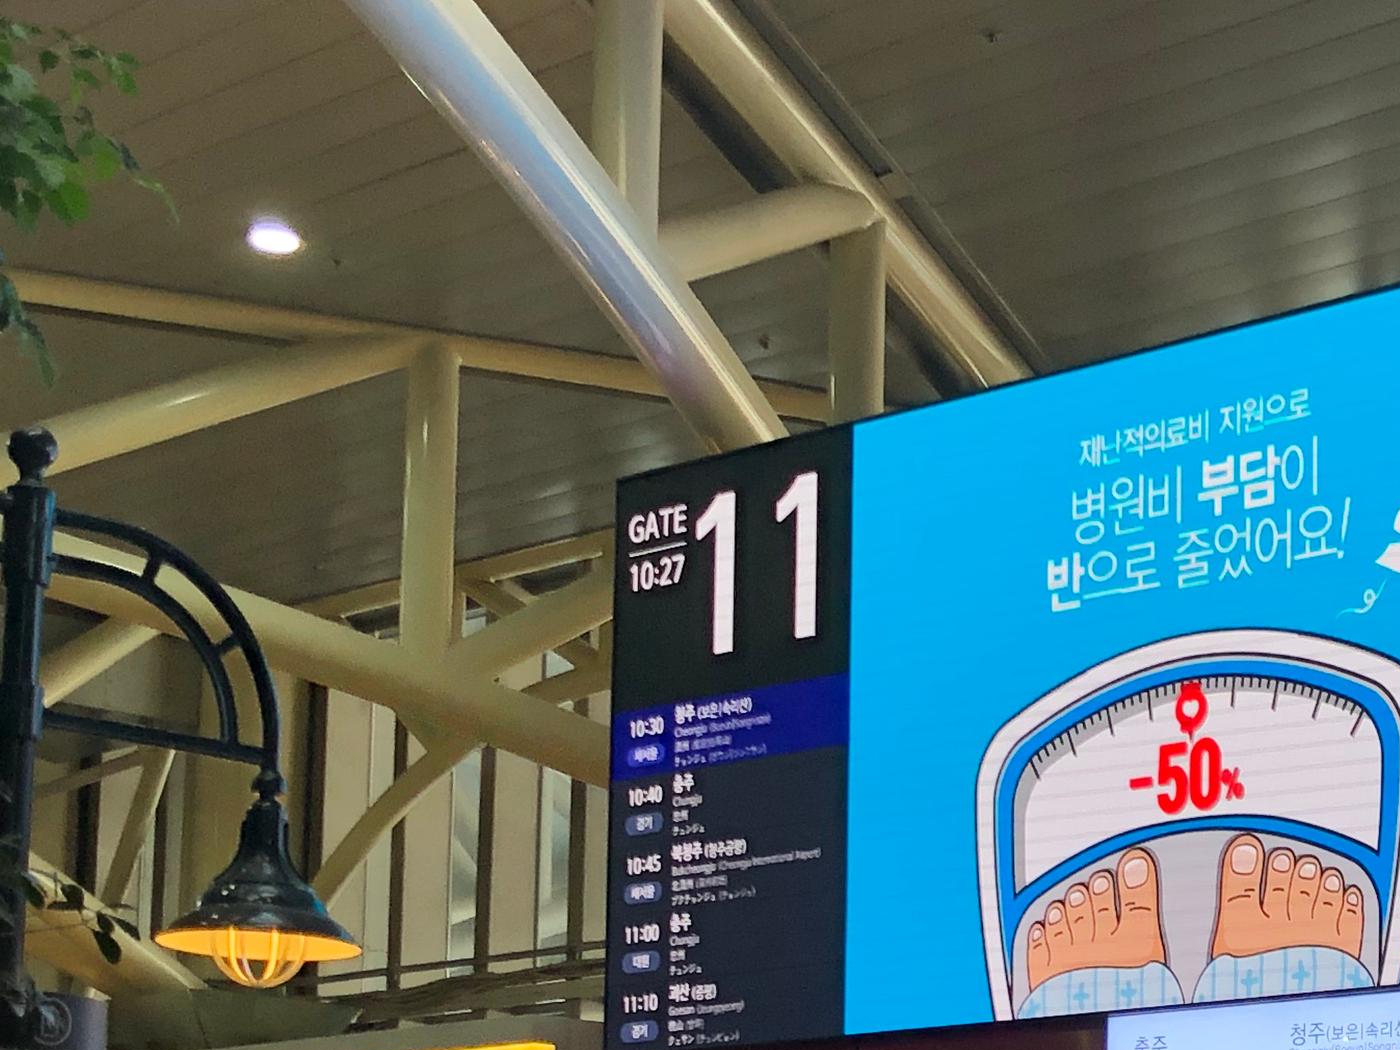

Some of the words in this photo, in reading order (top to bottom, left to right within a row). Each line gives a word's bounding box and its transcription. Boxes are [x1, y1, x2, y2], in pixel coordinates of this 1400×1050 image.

[1079, 408, 1210, 468] 재난적의료비
[1219, 388, 1311, 435] 지원으로
[1071, 465, 1182, 546] 병원비
[1197, 435, 1319, 517] 부담이
[628, 503, 688, 543] GATE
[629, 554, 686, 592] 10:27
[1047, 540, 1160, 613] 반으로
[1173, 496, 1351, 589] 줄었어요!
[630, 716, 665, 738] 10:30
[1129, 737, 1245, 815] -50%
[629, 785, 663, 807] 10:40
[627, 854, 662, 875] 10:45
[625, 924, 660, 944] 11:00
[624, 993, 659, 1013] 11:10
